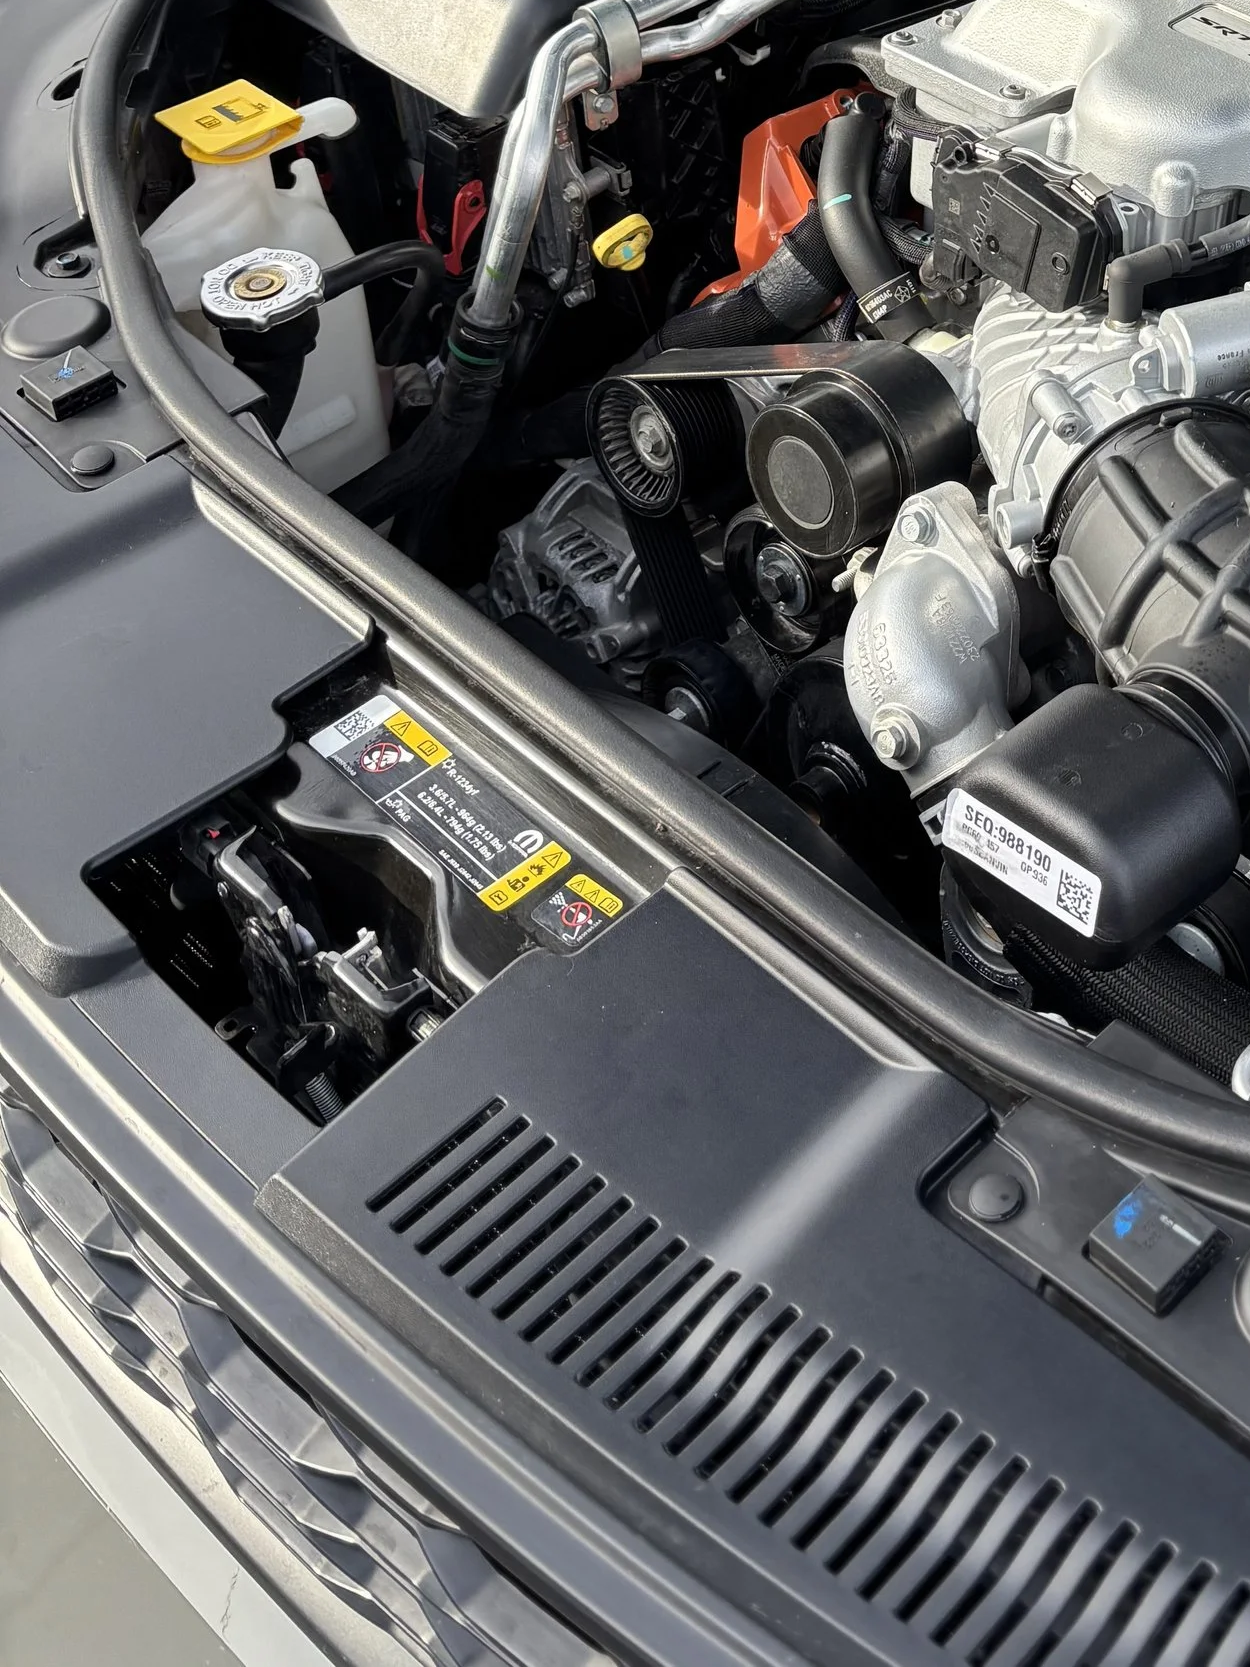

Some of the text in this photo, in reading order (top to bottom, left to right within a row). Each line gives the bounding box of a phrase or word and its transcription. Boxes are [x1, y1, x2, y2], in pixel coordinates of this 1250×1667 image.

[212, 295, 247, 311] OPEN
[251, 296, 280, 310] HOT
[1217, 349, 1244, 361] France
[446, 768, 480, 796] R-1234yf
[394, 808, 411, 823] PAG
[417, 791, 445, 817] 6.2/6.4L
[445, 816, 465, 835] 794g
[461, 831, 483, 849] (1.75
[478, 845, 496, 861] lbs)
[428, 784, 457, 809] 3.6/5.7L
[457, 808, 477, 827] 964g
[472, 823, 494, 842] (2.13
[489, 837, 507, 853] lbs)
[965, 805, 1051, 872] SEQ:988190
